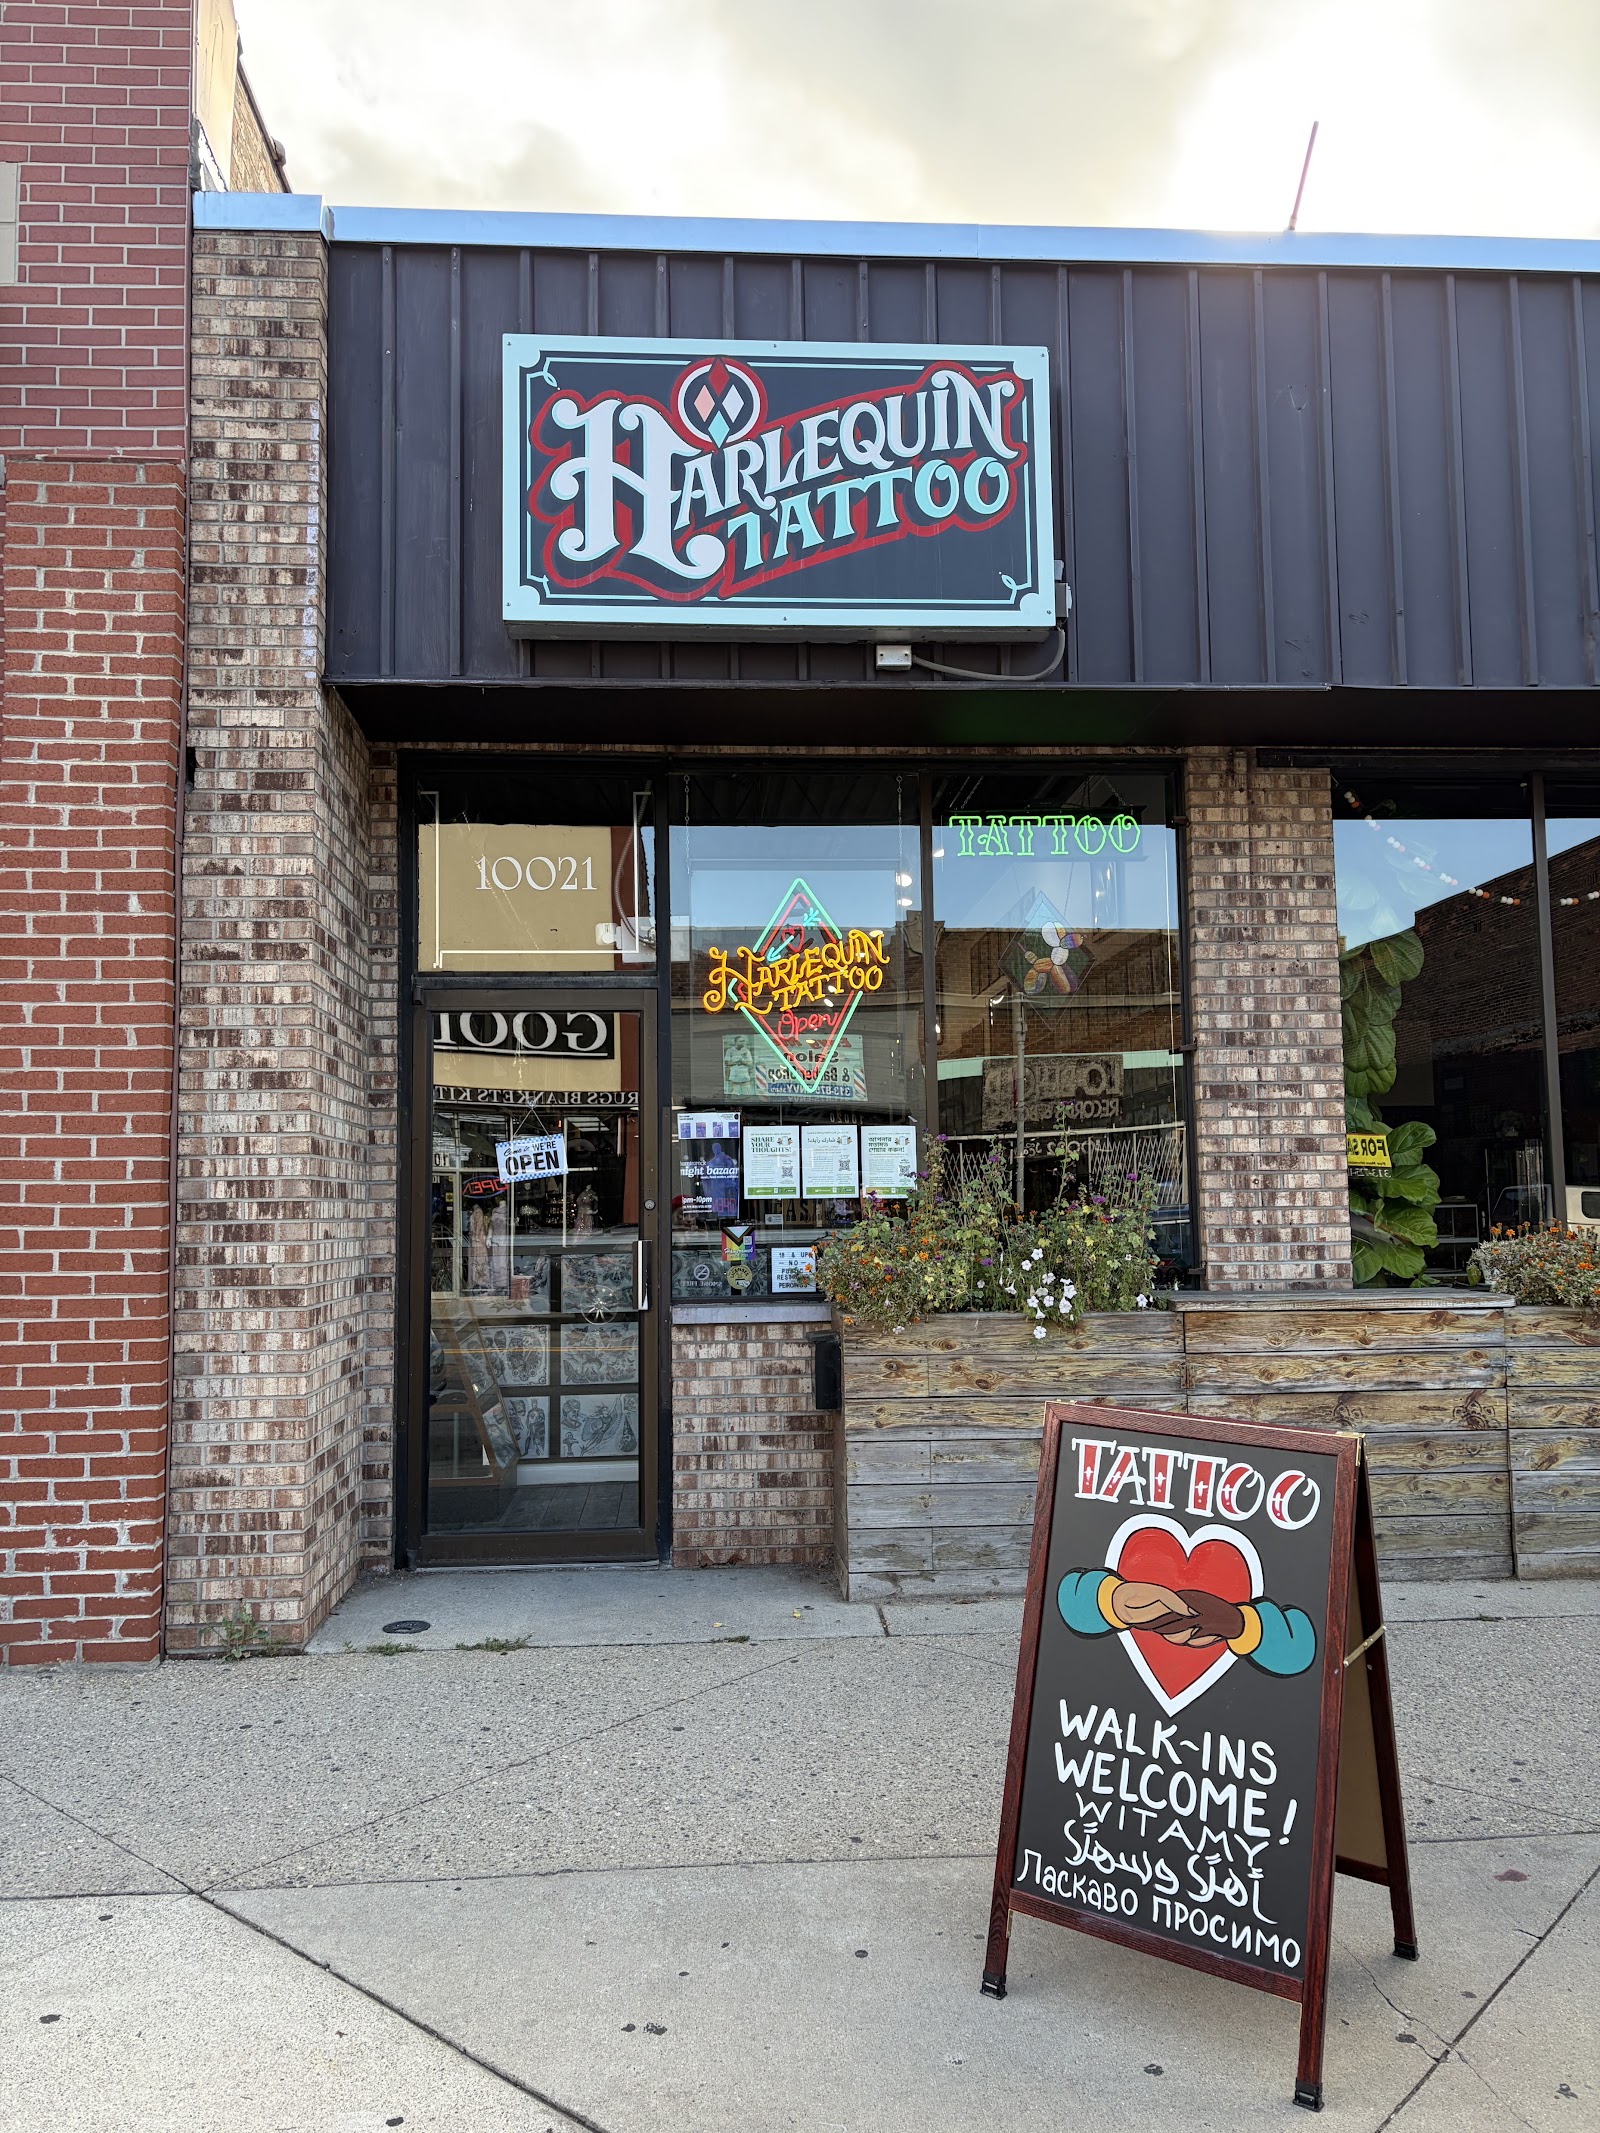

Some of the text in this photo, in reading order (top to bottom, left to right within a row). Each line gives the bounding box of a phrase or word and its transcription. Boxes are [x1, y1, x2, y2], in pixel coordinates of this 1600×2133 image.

[550, 369, 1019, 580] HARLEQUIN
[727, 456, 1010, 571] TATTOO
[949, 814, 1141, 857] TATTOO
[475, 856, 598, 891] 10021
[771, 964, 883, 1012] TATTOO
[777, 1009, 839, 1041] Open
[505, 1150, 560, 1176] OPEN
[532, 1140, 557, 1151] WE'RE
[680, 1166, 705, 1178] night
[706, 1165, 740, 1176] bazaar
[1071, 1438, 1321, 1530] TATTOO
[1058, 1698, 1279, 1787] WALK-INS
[1055, 1741, 1298, 1847] WELCOME!
[1075, 1793, 1269, 1868] WITAMY
[1016, 1848, 1139, 1916] Ласкаво
